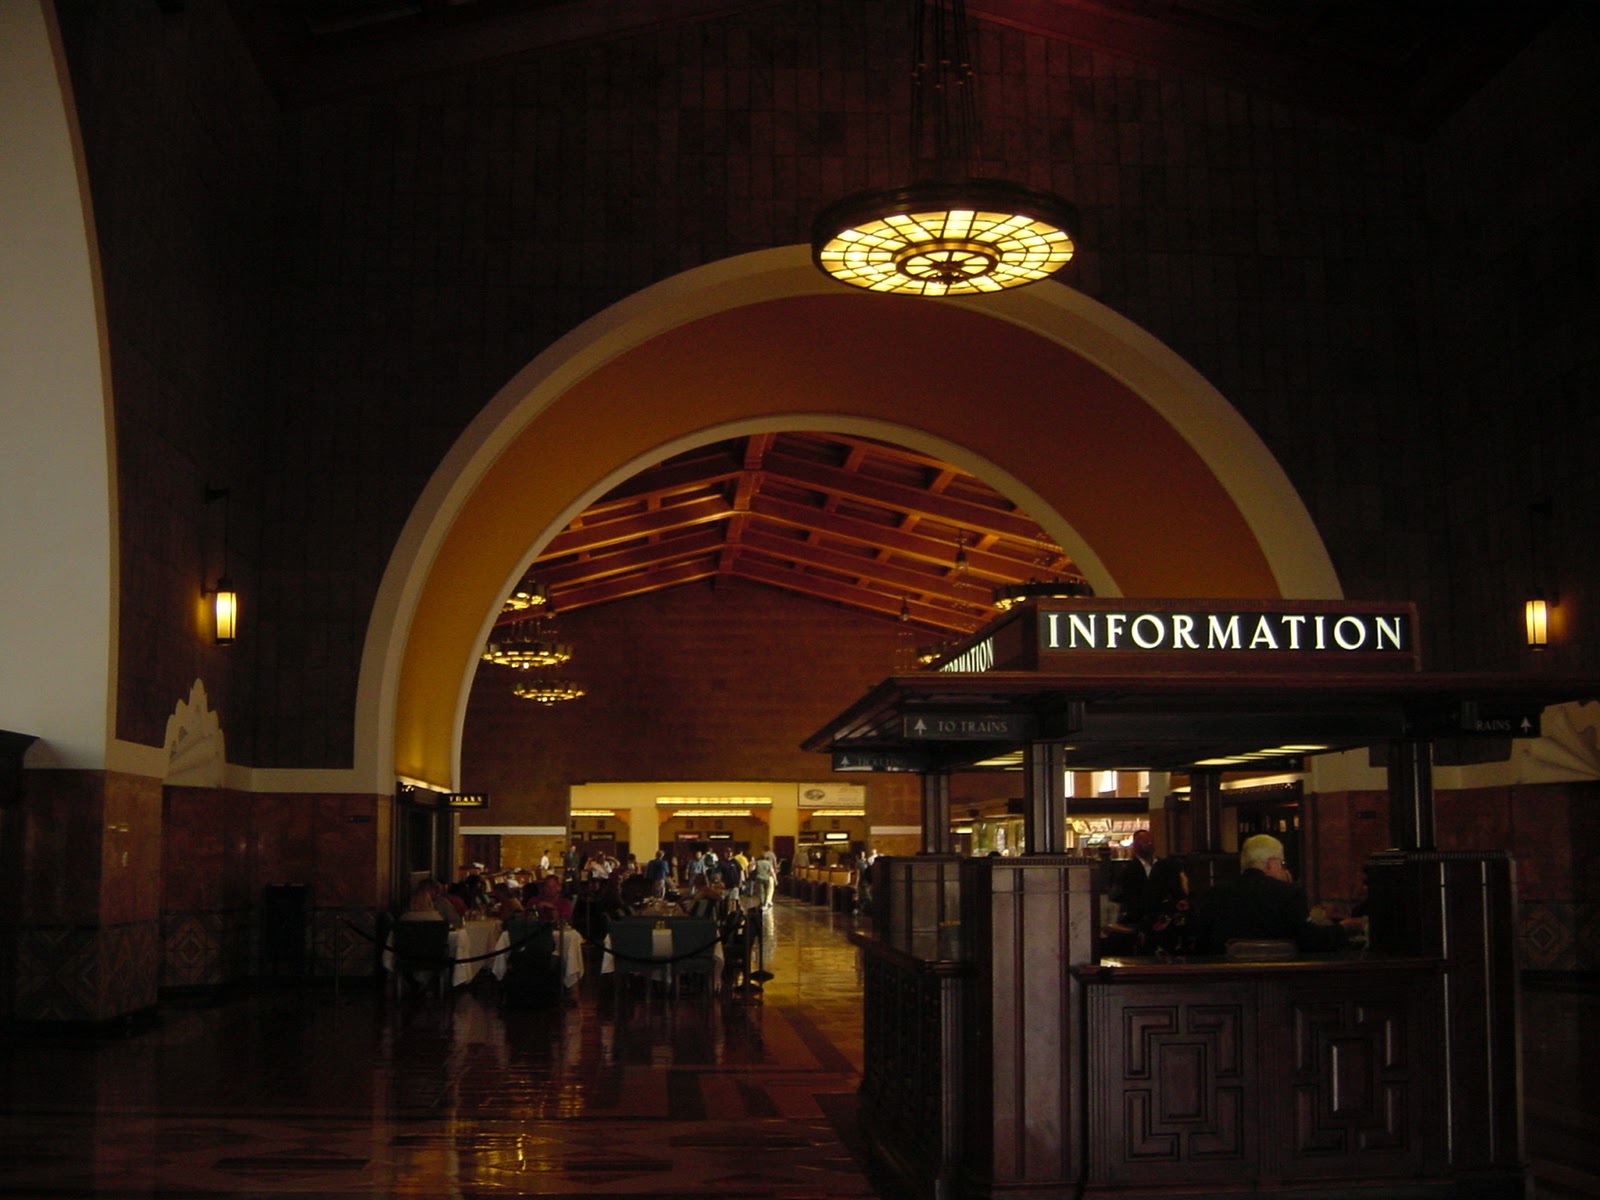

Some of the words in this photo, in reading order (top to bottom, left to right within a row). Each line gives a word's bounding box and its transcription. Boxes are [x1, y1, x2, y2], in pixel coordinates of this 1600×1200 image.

[1048, 613, 1402, 650] INFORMATION
[938, 721, 956, 732] TO
[960, 720, 1008, 733] TRAINS
[1475, 720, 1512, 732] RAINS
